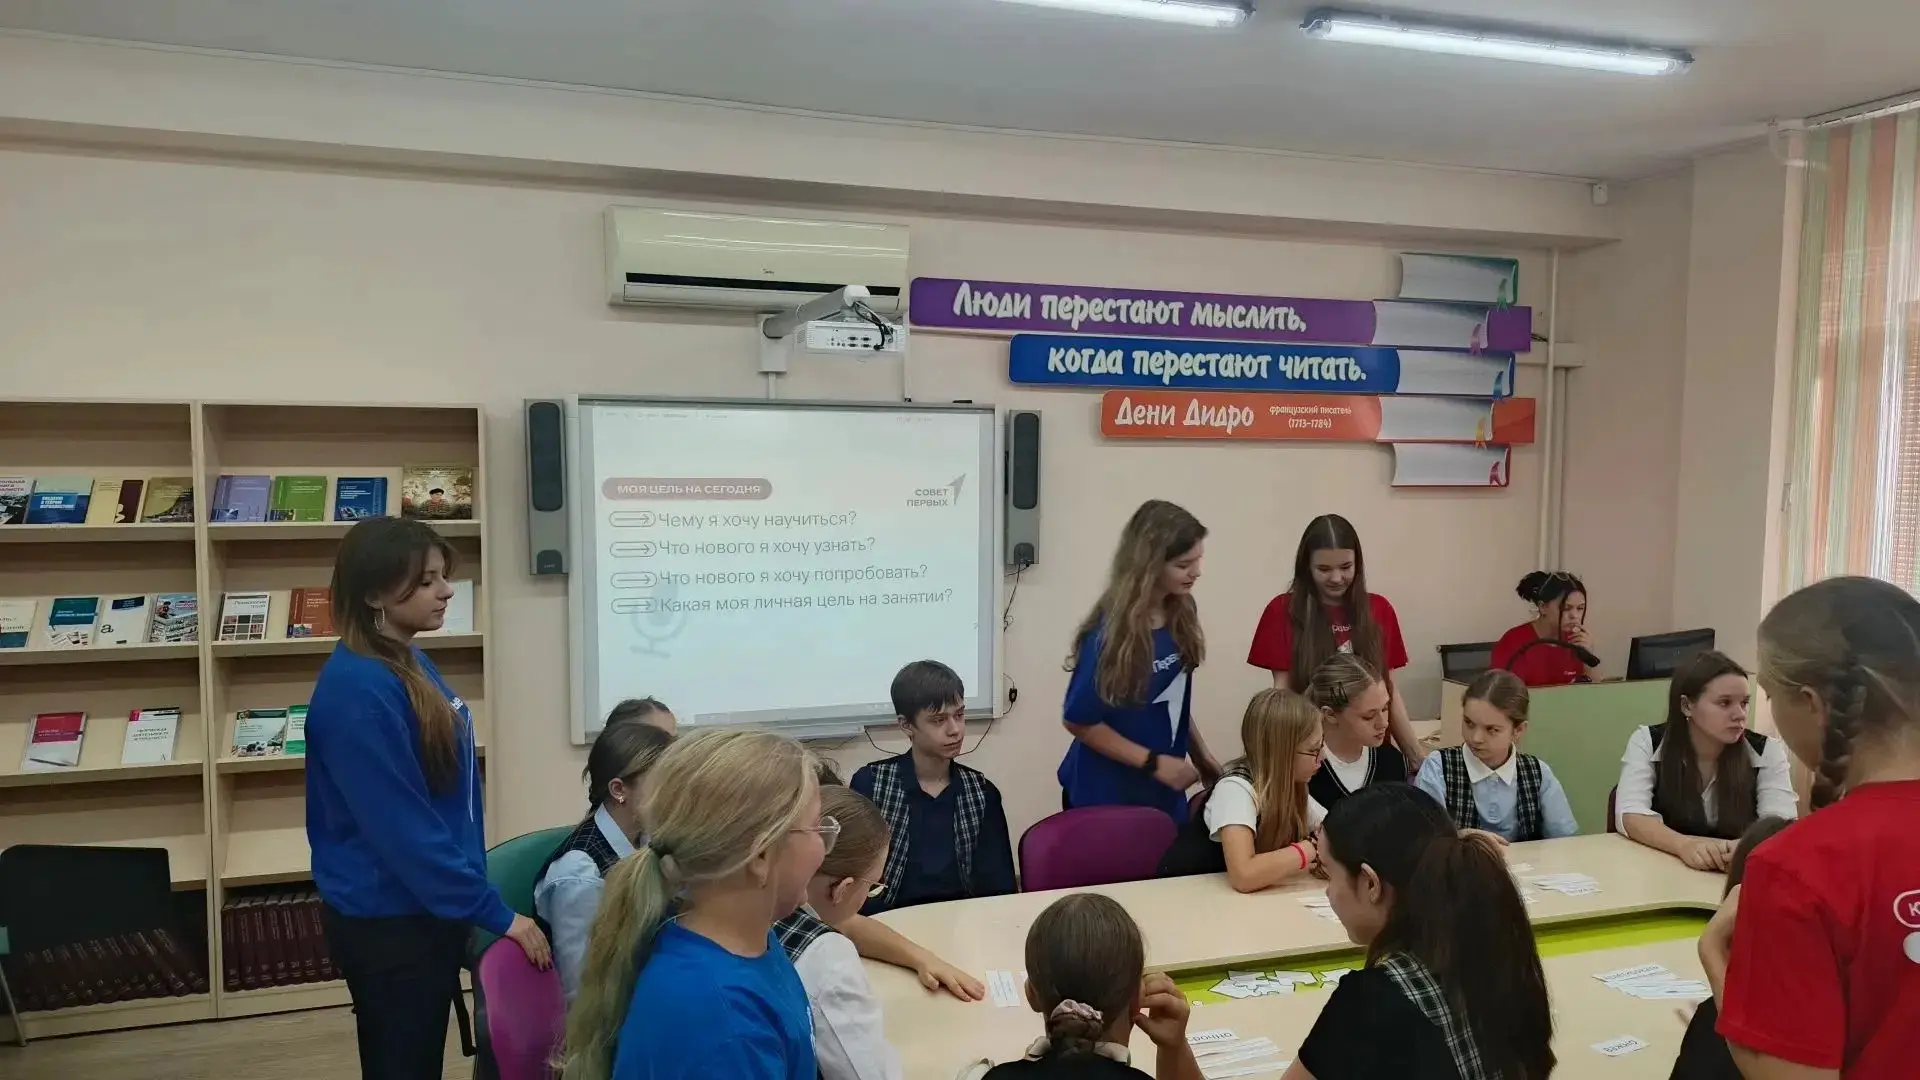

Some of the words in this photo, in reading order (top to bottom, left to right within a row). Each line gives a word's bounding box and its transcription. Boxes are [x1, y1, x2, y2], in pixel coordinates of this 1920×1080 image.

[953, 281, 1031, 320] Люди
[1040, 292, 1182, 329] перестают
[1190, 301, 1308, 332] мыслить,
[1048, 347, 1123, 376] когда
[1133, 349, 1272, 385] перестают
[1279, 353, 1367, 382] читать.
[1114, 397, 1176, 427] Дени
[1182, 397, 1255, 434] Дидро
[1269, 405, 1318, 416] французский
[1320, 406, 1352, 415] писатель
[617, 485, 647, 494] МОЯ
[650, 485, 683, 495] ЦЕЛЬ
[685, 485, 702, 494] НА
[704, 485, 761, 495] СЕГОДНЯ
[914, 488, 949, 497] СОВЕТ
[906, 499, 949, 507] ПЕРВЫХ
[658, 511, 704, 531] Чему
[708, 515, 718, 527] я
[722, 514, 760, 530] хочу
[764, 511, 858, 527] научиться?
[660, 540, 690, 556] Что
[695, 541, 755, 555] нового
[760, 542, 769, 554] я
[773, 540, 810, 557] хочу
[814, 537, 876, 556] узнать?
[660, 570, 690, 586] Что
[695, 571, 755, 585] нового
[760, 571, 770, 583] я
[773, 569, 810, 587] хочу
[814, 564, 929, 585] попробовать?
[661, 598, 711, 613] Какая
[716, 598, 750, 611] моя
[754, 595, 812, 609] личная
[816, 593, 854, 610] цель
[859, 594, 878, 606] на
[881, 588, 953, 606] занятии?
